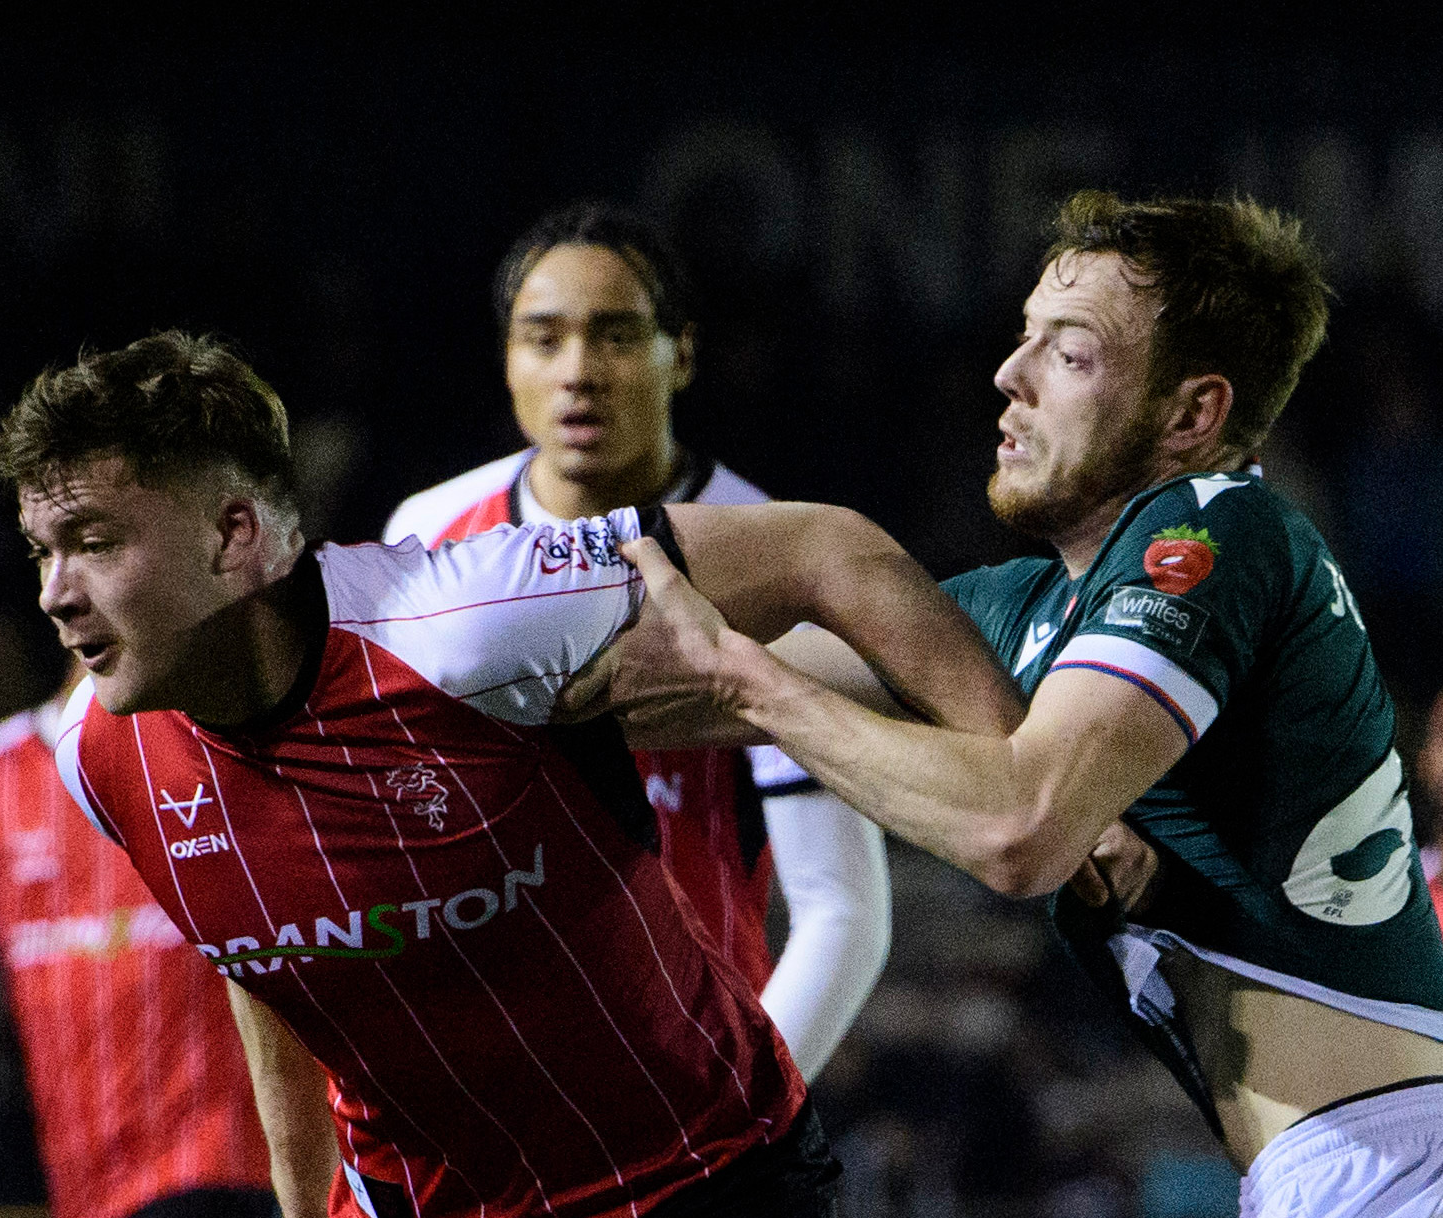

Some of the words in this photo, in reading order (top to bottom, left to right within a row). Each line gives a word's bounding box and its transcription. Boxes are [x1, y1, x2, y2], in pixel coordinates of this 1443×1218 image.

[1120, 594, 1192, 631] whites
[169, 832, 230, 860] OXEN
[195, 842, 546, 976] BRANSTON
